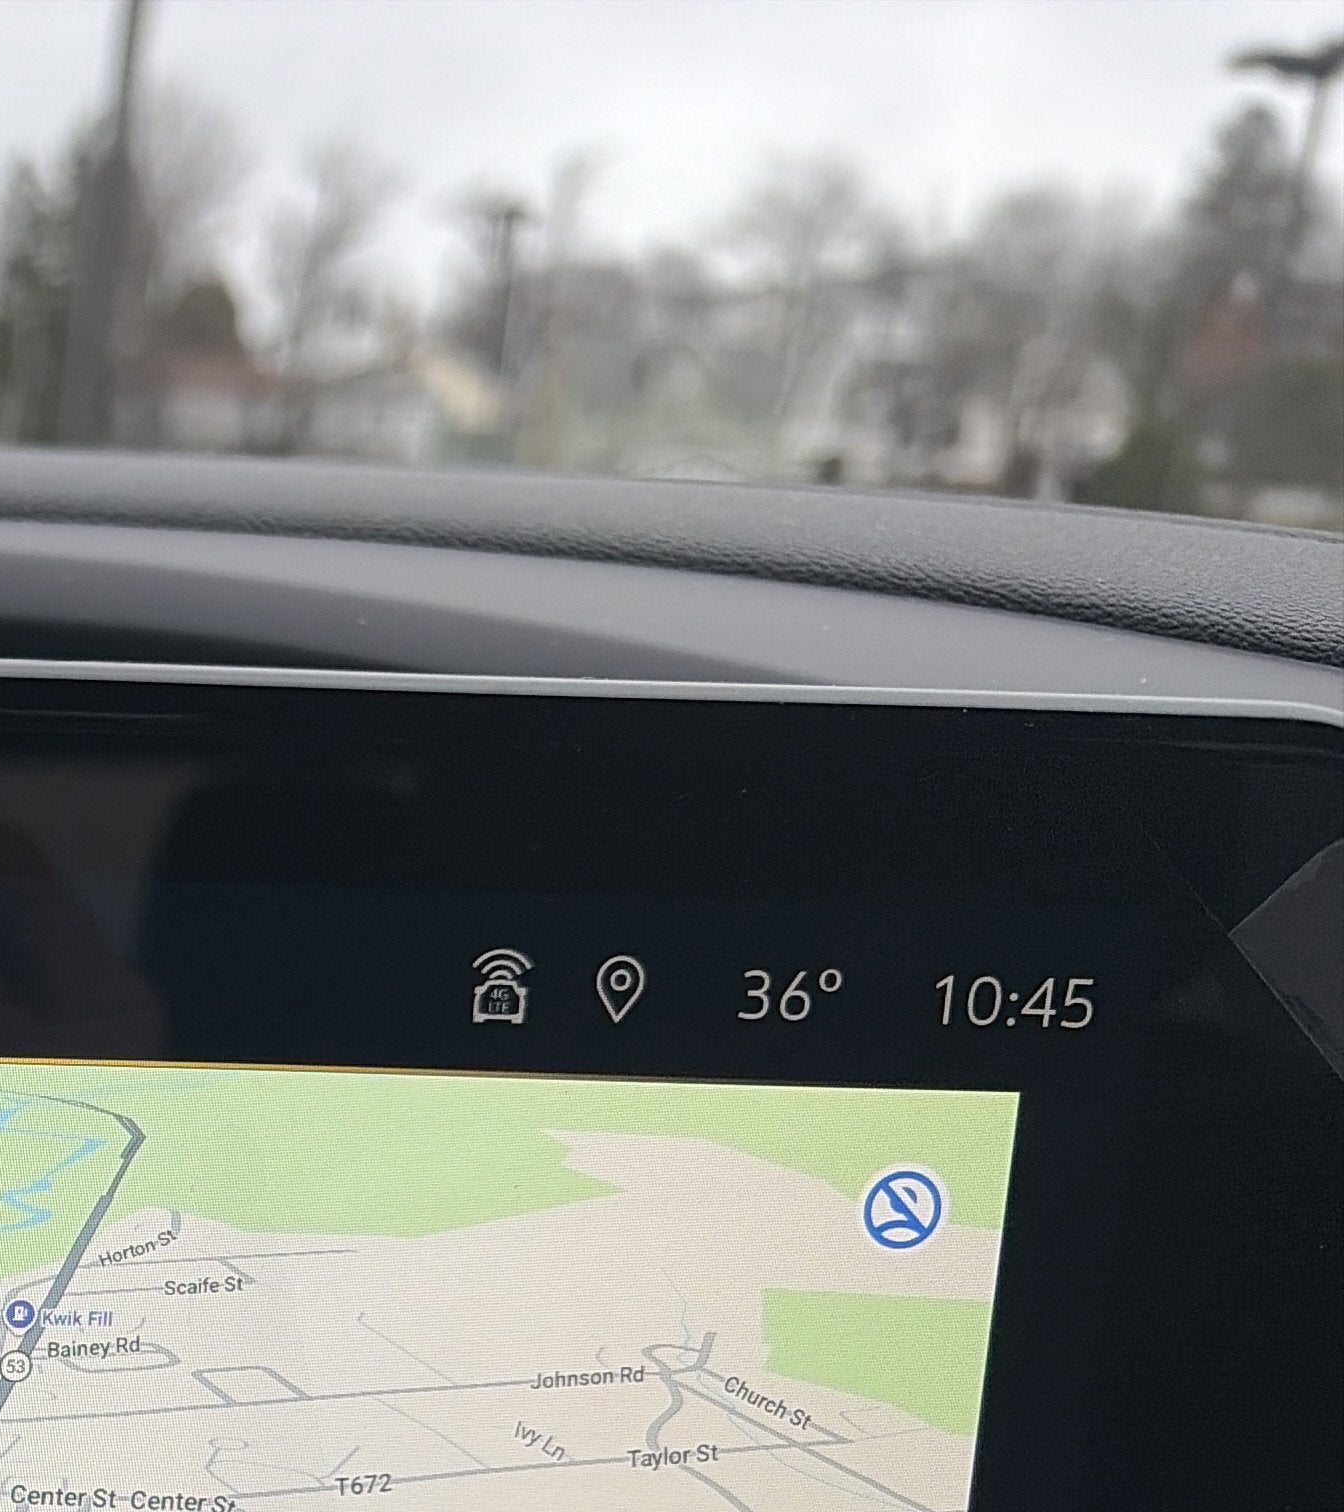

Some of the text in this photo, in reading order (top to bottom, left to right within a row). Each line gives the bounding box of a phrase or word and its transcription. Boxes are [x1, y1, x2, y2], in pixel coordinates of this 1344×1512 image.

[489, 987, 509, 1000] 4G
[933, 974, 1095, 1029] 10:45
[488, 1001, 510, 1013] LTE
[98, 1229, 178, 1267] Horton St
[164, 1276, 244, 1296] Scaife St
[42, 1310, 113, 1328] Kwik Fill
[47, 1336, 141, 1360] Bainey Rd
[530, 1366, 645, 1391] Johnson Rd
[723, 1377, 812, 1431] Church St
[514, 1421, 566, 1461] Ivy Ln
[628, 1442, 718, 1472] Taylor St
[335, 1474, 392, 1496] T672
[11, 1486, 116, 1509] Center St
[131, 1490, 205, 1512] Center
